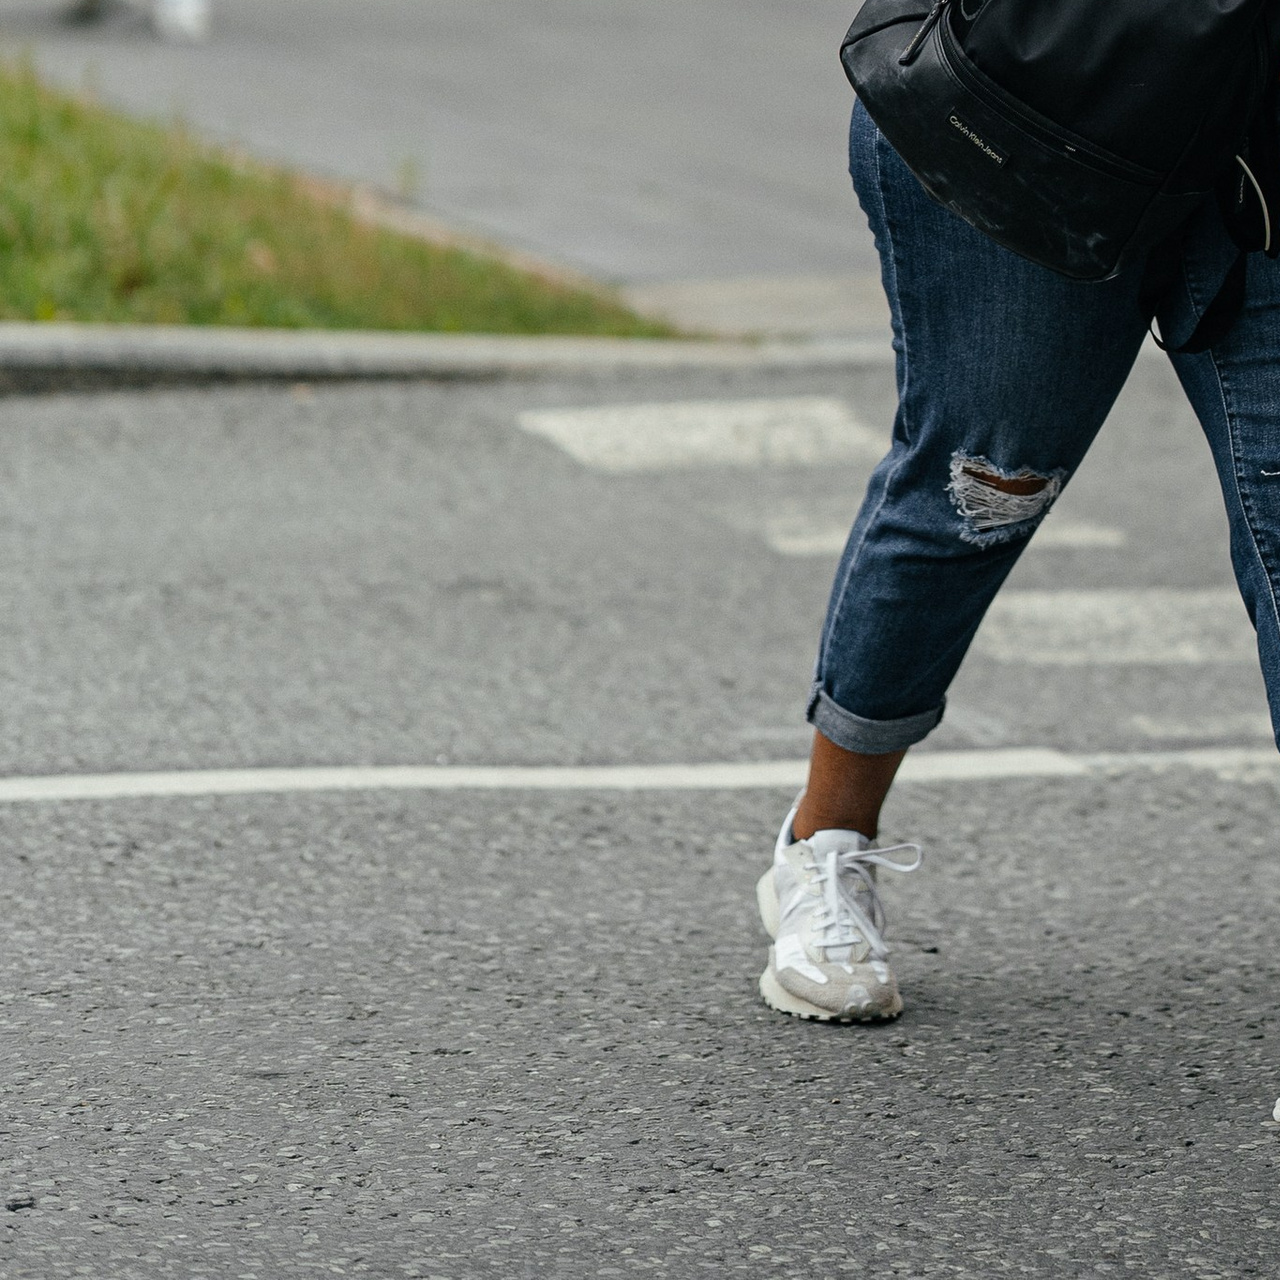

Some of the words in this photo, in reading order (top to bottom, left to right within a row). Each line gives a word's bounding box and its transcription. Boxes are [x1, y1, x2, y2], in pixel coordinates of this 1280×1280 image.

[949, 115, 970, 137] Calvin
[968, 131, 985, 149] Klein
[982, 145, 1003, 164] Jeans
